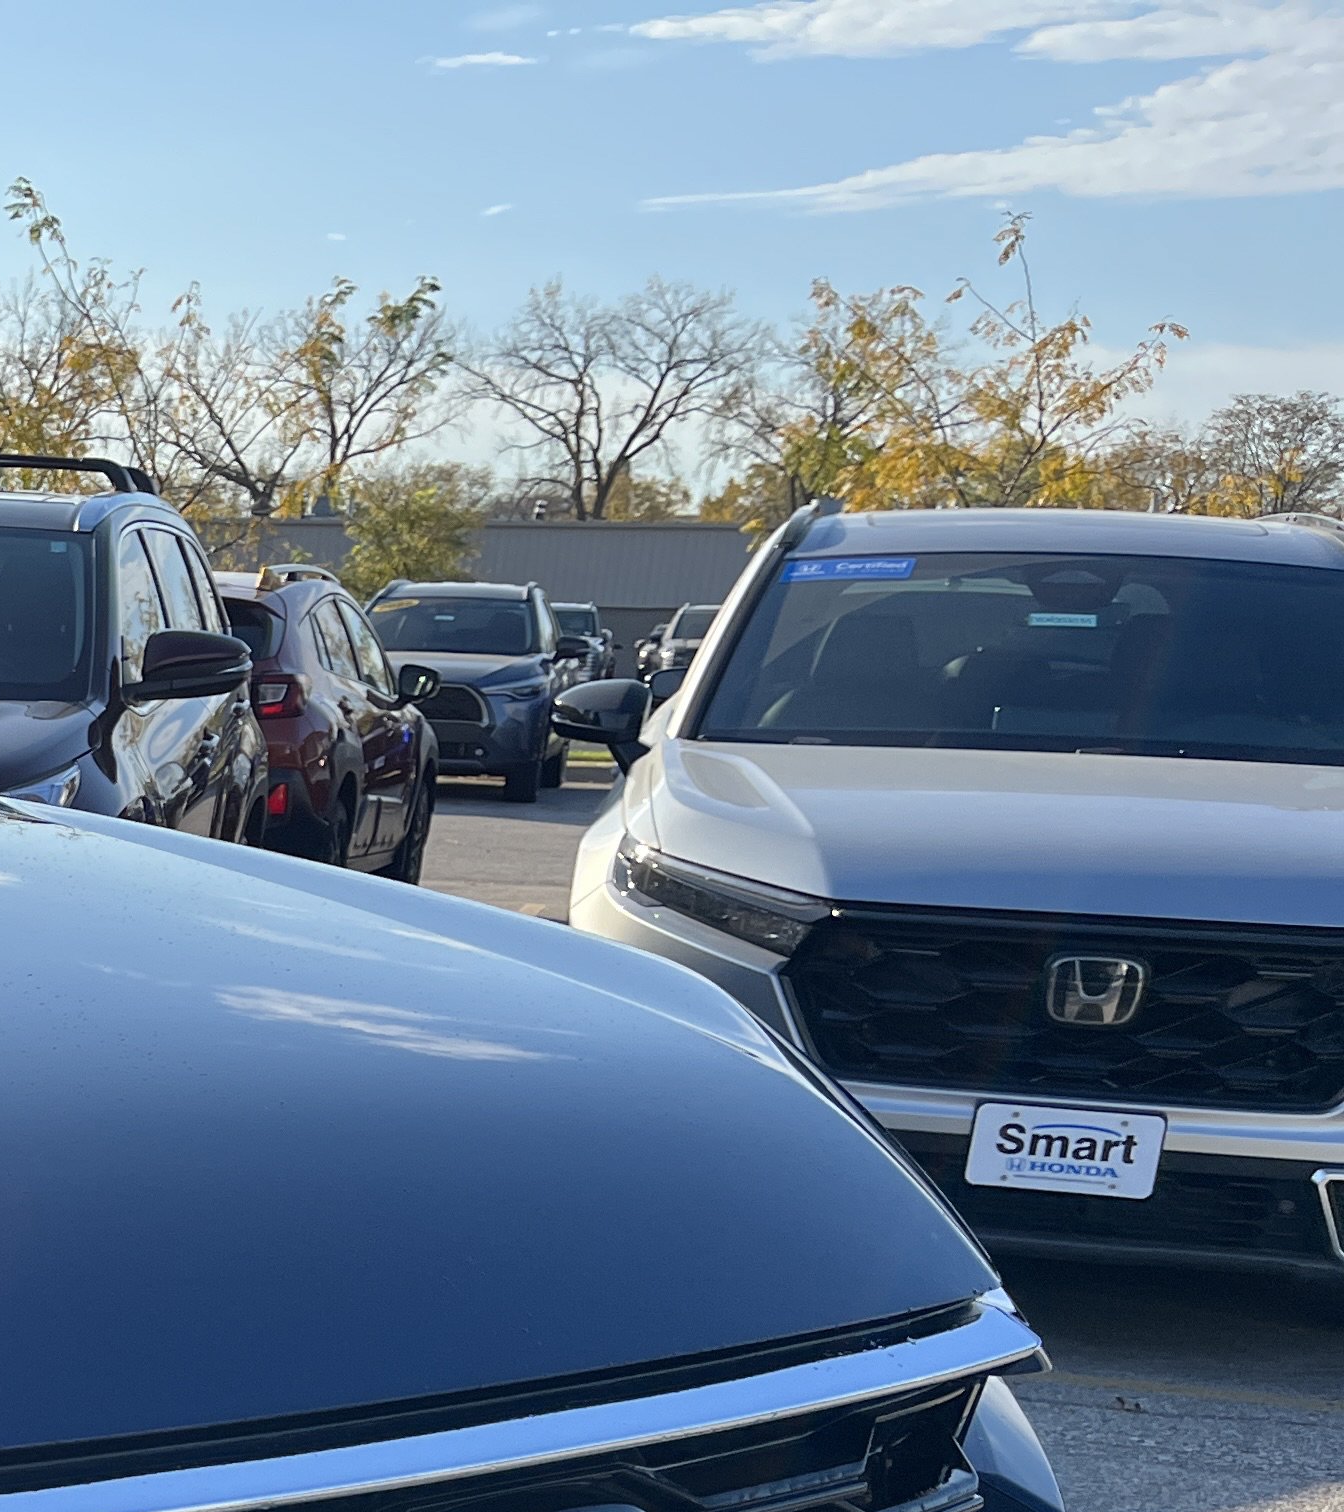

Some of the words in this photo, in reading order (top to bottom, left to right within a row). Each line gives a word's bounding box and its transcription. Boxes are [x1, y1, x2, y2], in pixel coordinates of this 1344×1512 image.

[835, 560, 909, 570] Certified
[996, 1123, 1138, 1164] Smart
[1029, 1160, 1119, 1178] HONDA
